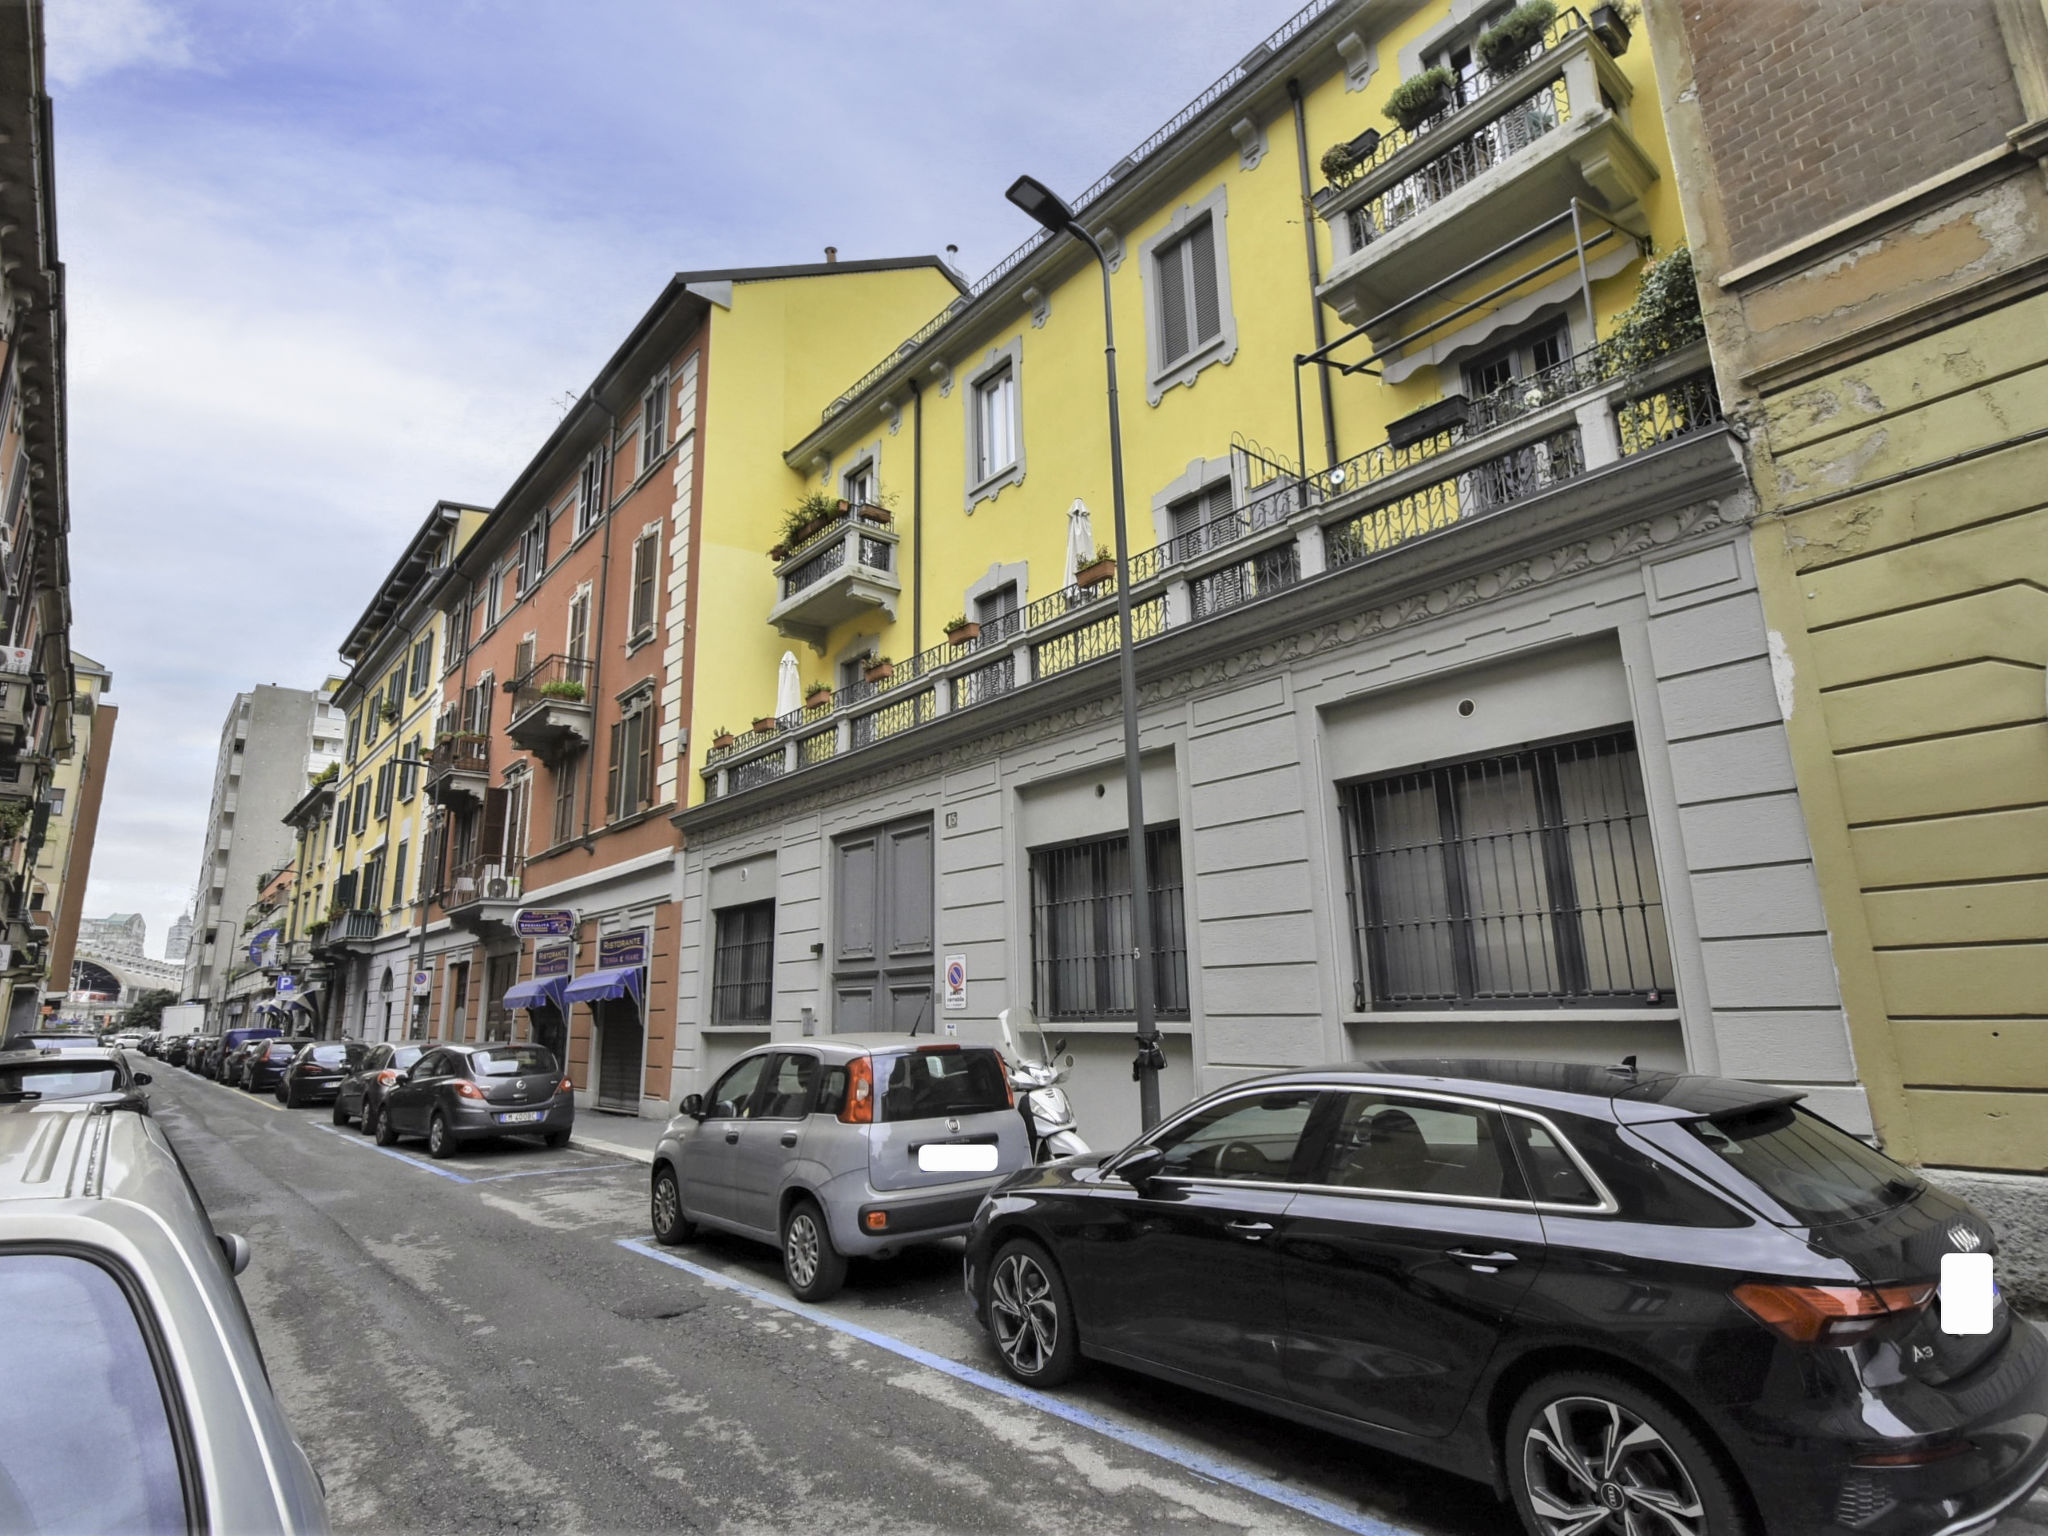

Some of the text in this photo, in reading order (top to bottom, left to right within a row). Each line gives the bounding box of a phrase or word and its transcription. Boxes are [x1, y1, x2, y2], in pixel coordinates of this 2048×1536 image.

[603, 937, 641, 949] RISTORANTE
[539, 950, 568, 959] RISTORANTE
[280, 978, 291, 989] P
[1912, 1345, 1934, 1363] A3
